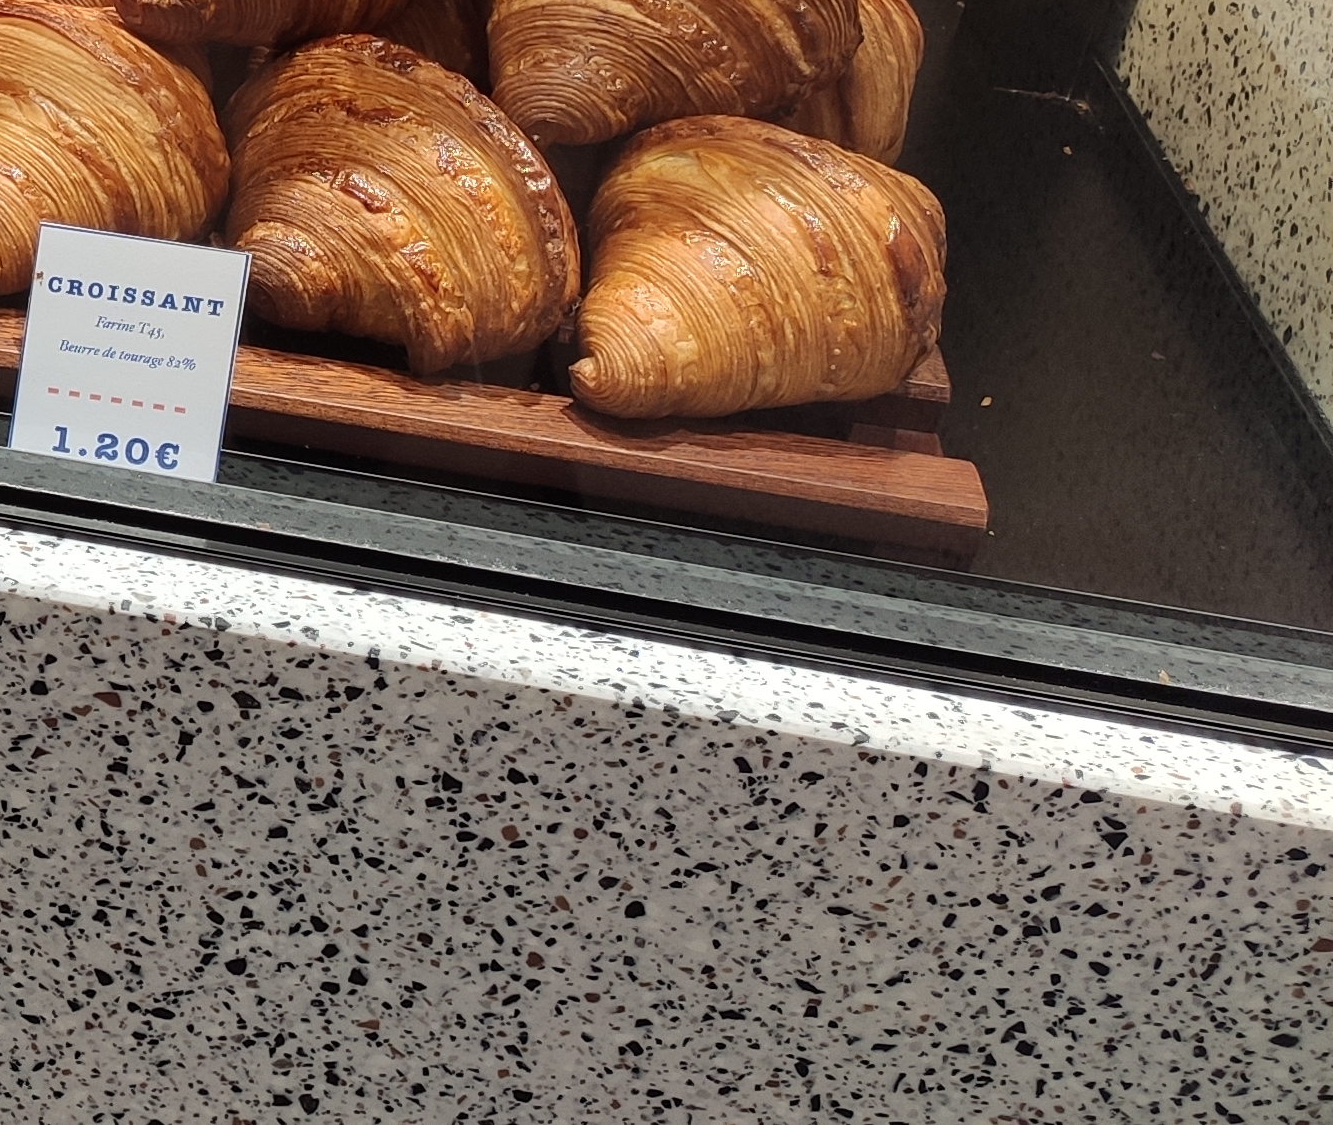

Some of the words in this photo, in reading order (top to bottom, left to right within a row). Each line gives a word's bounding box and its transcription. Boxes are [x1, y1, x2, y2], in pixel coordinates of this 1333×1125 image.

[48, 277, 224, 317] CROISSANT
[95, 316, 135, 332] Farine
[59, 340, 100, 355] Beurre
[102, 347, 116, 359] de
[119, 351, 164, 368] tourage
[166, 356, 196, 371] 82%
[52, 426, 180, 470] 1.20€
